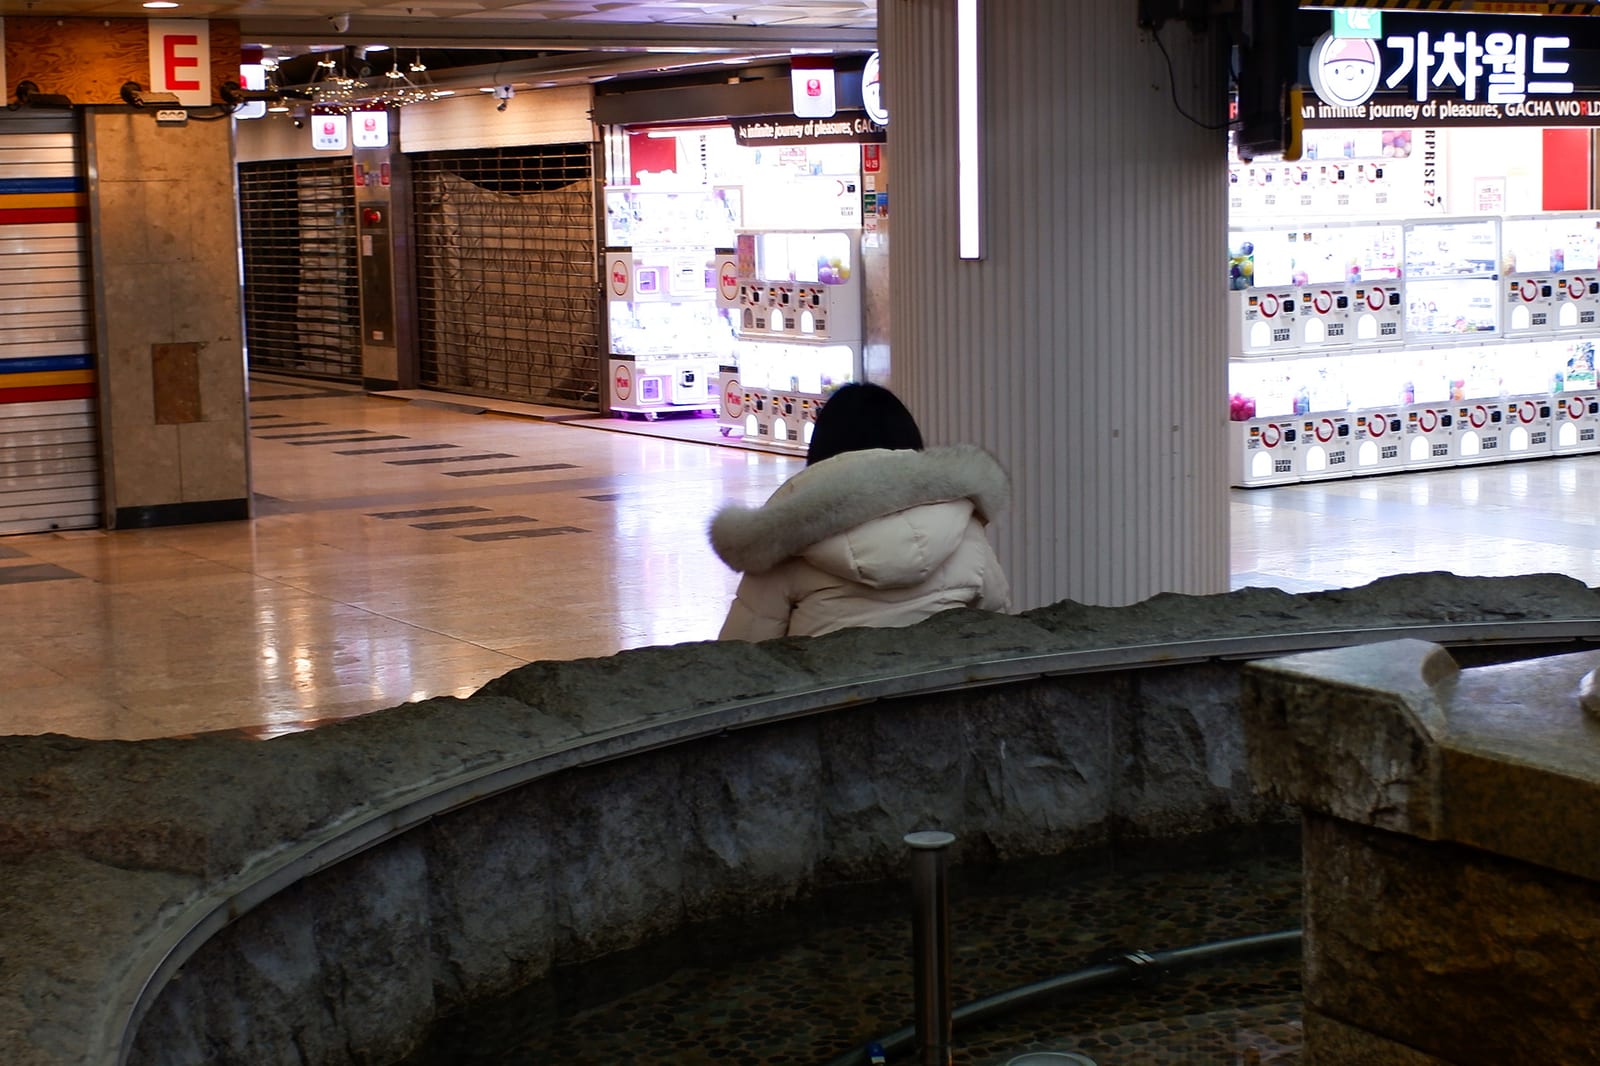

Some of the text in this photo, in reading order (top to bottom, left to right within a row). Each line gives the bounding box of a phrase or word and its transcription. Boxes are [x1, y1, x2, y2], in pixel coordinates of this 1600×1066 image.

[163, 34, 200, 91] E
[1385, 31, 1575, 104] 가챠월드
[747, 123, 774, 138] infinite
[774, 122, 803, 139] journey
[804, 120, 813, 136] of
[814, 119, 853, 138] pleasures,
[1318, 102, 1366, 119] infinite
[1369, 101, 1420, 120] journey
[1422, 100, 1437, 117] of
[1439, 100, 1502, 119] pleasures,
[1505, 101, 1555, 117] GACHA
